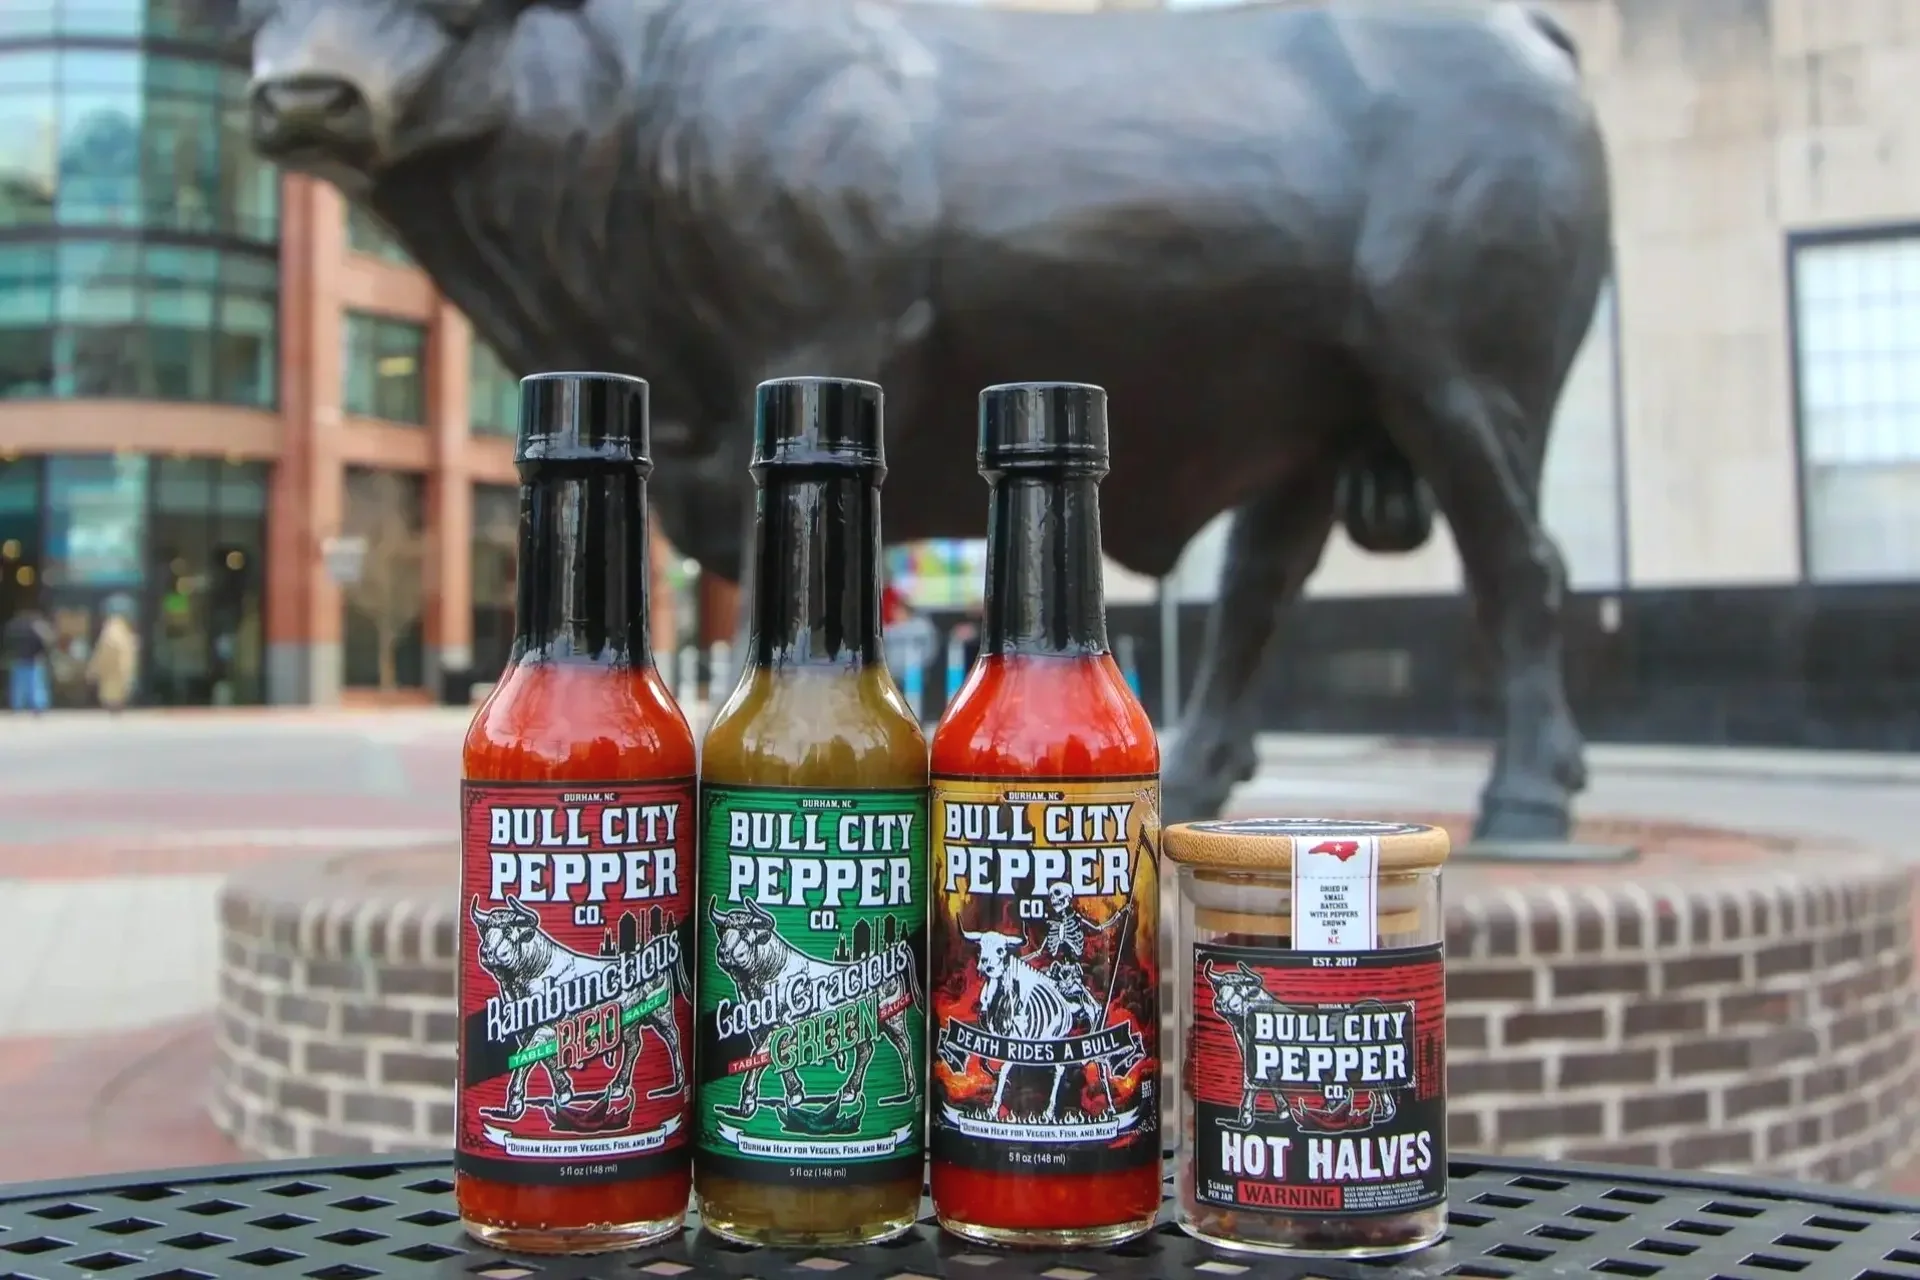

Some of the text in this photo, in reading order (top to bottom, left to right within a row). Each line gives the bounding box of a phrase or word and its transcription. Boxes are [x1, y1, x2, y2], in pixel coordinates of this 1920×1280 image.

[564, 792, 616, 802] DURHAM, NC
[802, 800, 852, 808] DURHAM, NC
[1008, 792, 1059, 801] DURHAM, NC
[490, 804, 679, 846] BULL CITY
[730, 811, 914, 851] BULL CITY
[945, 803, 1134, 842] BULL CITY
[490, 848, 678, 900] PEPPER
[728, 854, 912, 906] PEPPER
[945, 845, 1130, 895] PEPPER
[574, 906, 604, 924] CO.
[810, 910, 839, 930] CO.
[1019, 900, 1049, 918] CO.
[1312, 956, 1358, 967] EST. 2017
[486, 930, 680, 1043] Rambunctious
[716, 940, 909, 1041] Good Gracious
[624, 996, 661, 1021] SAUCE
[880, 993, 911, 1016] SAUCE
[555, 1002, 622, 1070] RED
[770, 993, 881, 1074] GREEN
[1254, 1012, 1406, 1042] BULL CITY
[514, 1044, 556, 1065] TABLE
[956, 1028, 1120, 1061] DEATH RIDES A BULL
[732, 1054, 769, 1072] TABLE
[1254, 1044, 1406, 1082] PEPPER
[1324, 1085, 1347, 1099] CO.
[1008, 1152, 1066, 1165] 5 fl oz (148 ml)
[1221, 1130, 1432, 1180] HOT HALVES
[560, 1164, 618, 1176] 5 fl oz (148 ml)
[790, 1168, 795, 1176] 5
[796, 1167, 802, 1176] fl
[814, 1168, 832, 1177] (148
[833, 1168, 847, 1177] ml)
[1207, 1179, 1234, 1193] 5 GRAMS
[1208, 1190, 1233, 1201] PER JAR
[1244, 1184, 1334, 1206] WARNING
